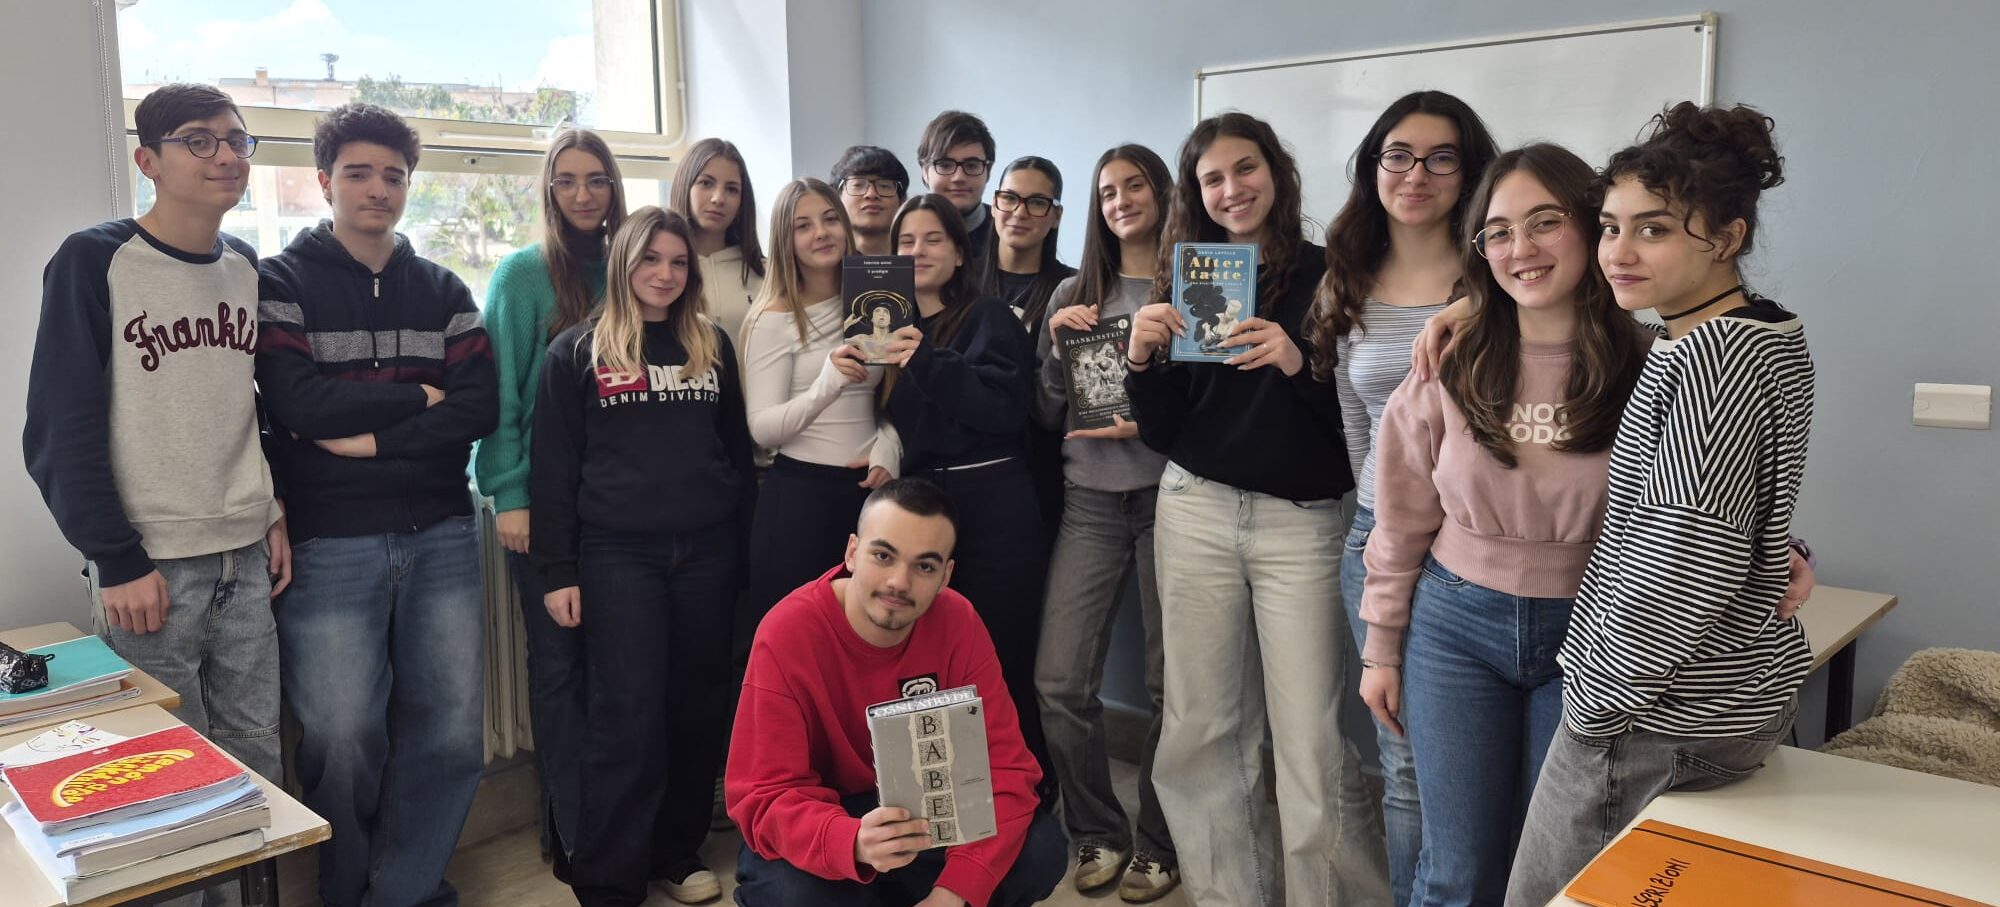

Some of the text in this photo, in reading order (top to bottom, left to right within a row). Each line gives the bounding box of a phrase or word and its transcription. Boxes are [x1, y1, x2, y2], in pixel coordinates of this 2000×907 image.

[1189, 256, 1244, 269] After
[1190, 269, 1242, 281] taste
[124, 302, 257, 372] Frankli
[1065, 330, 1125, 346] FRANKENSTEIN
[600, 392, 648, 408] DENIM
[1504, 423, 1573, 444] ODA
[920, 715, 951, 842] BABEL
